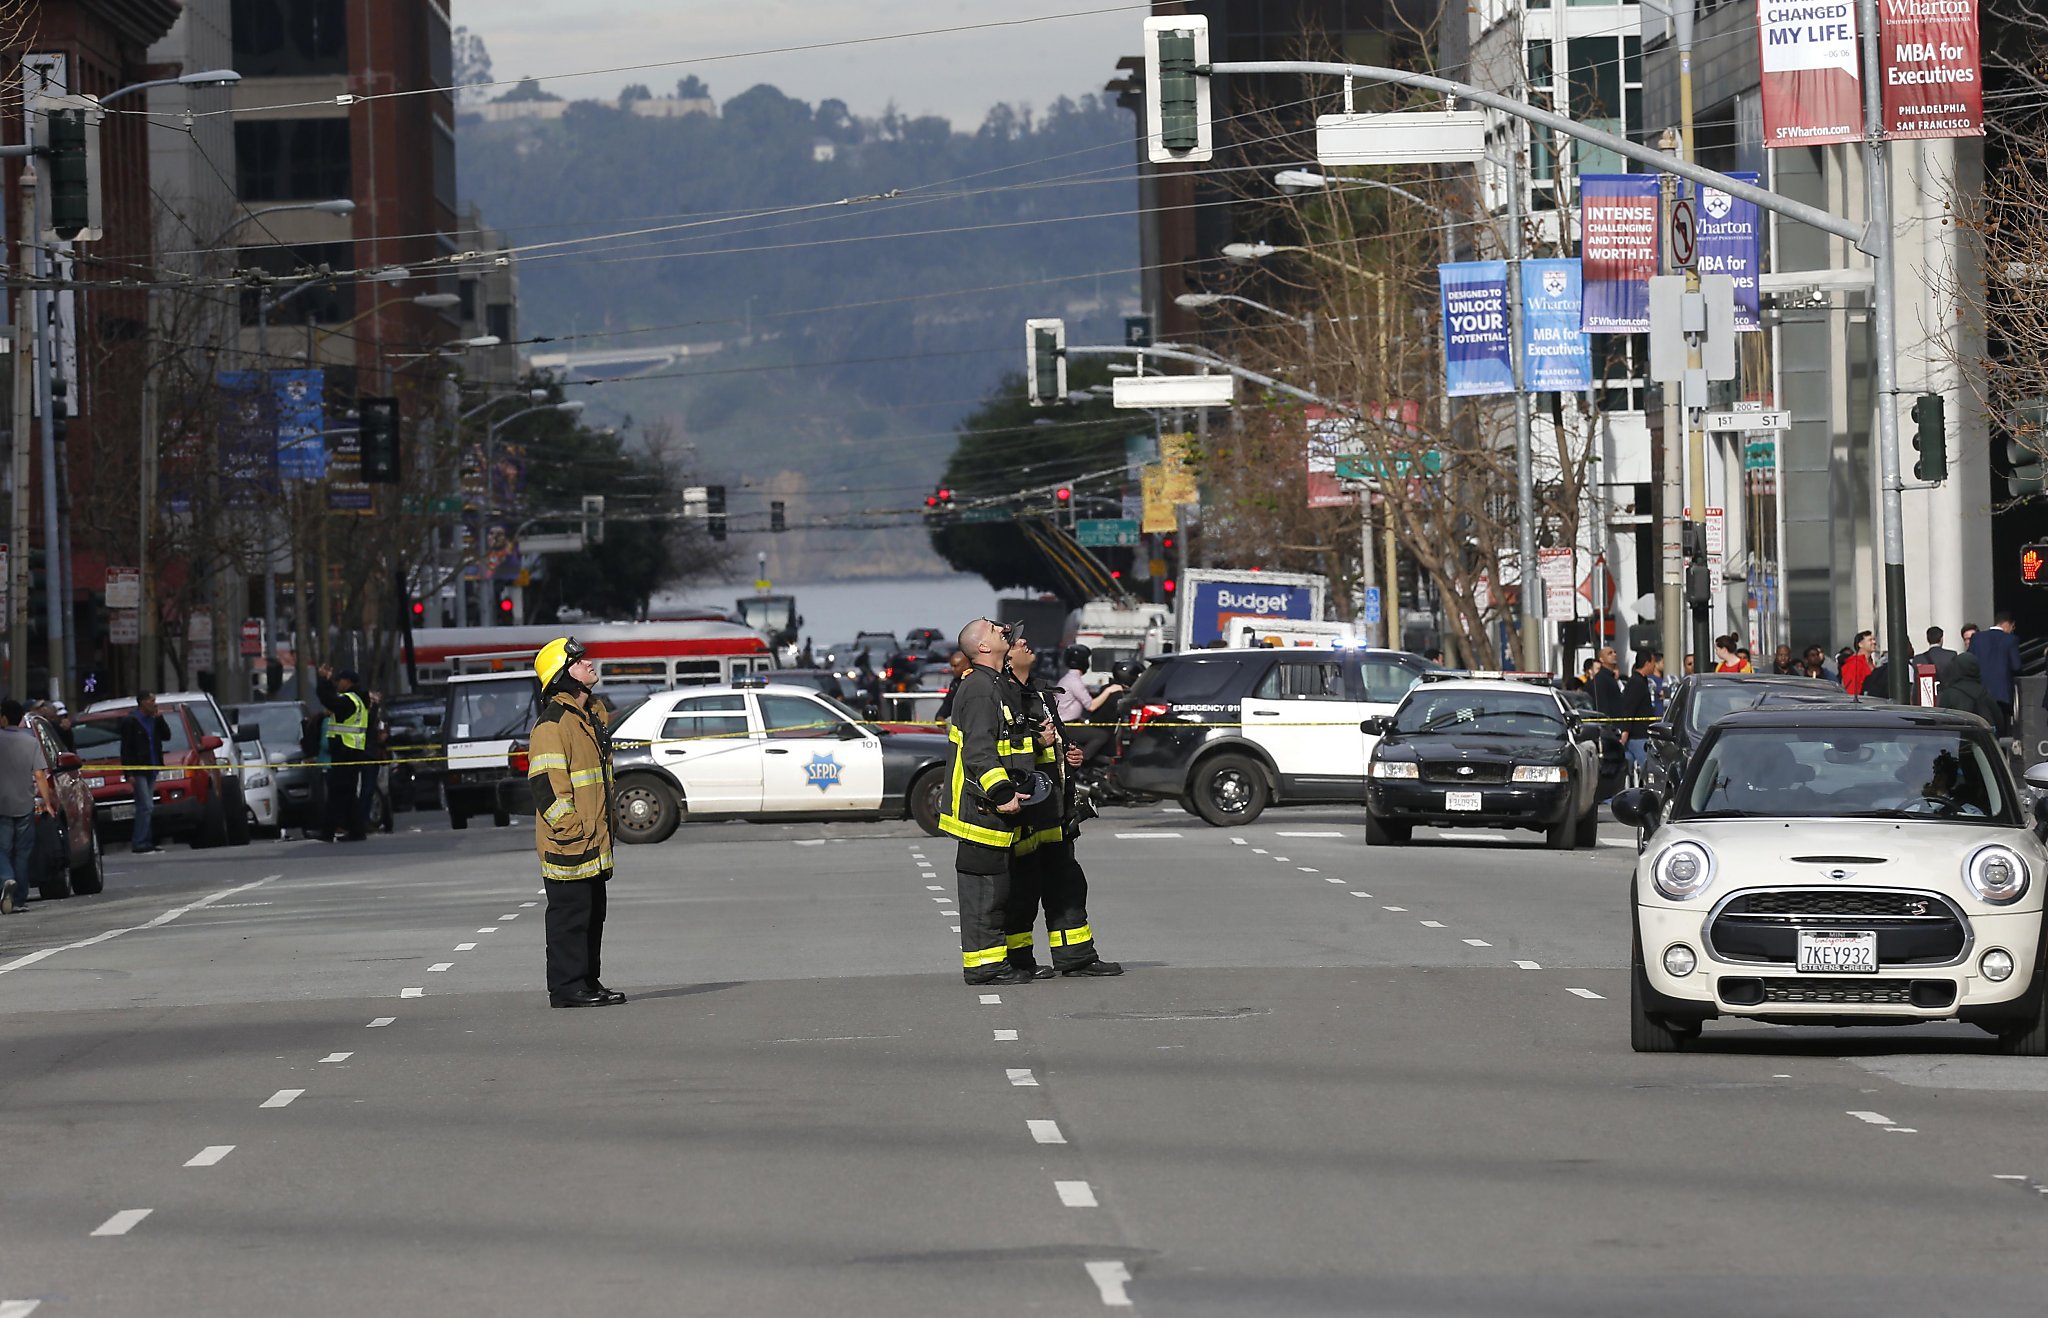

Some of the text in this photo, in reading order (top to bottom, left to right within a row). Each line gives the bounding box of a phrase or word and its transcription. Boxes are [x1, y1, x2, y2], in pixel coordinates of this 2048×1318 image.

[1768, 5, 1846, 22] CHANGED
[1887, 0, 1970, 16] Wharton
[1769, 24, 1853, 45] MY LIFE.
[1896, 42, 1964, 62] MBA for
[1888, 65, 1974, 85] Executives
[1898, 104, 1966, 116] PHILADELPHIA
[1896, 119, 1970, 130] SAN FRANCISCO
[1776, 126, 1850, 138] SFWharton.com
[1588, 207, 1654, 222] INTENSE,
[1588, 224, 1652, 232] CHALLENGING
[1588, 236, 1652, 244] AND TOTALLY
[1588, 248, 1654, 260] WORTH IT.
[1727, 255, 1747, 270] for
[1448, 288, 1502, 300] DESIGNED TO
[1449, 299, 1502, 314] UNLOCK
[1450, 313, 1504, 332] YOUR
[1589, 317, 1648, 326] SFWharton.com
[1452, 332, 1506, 344] POTENTIAL.
[1534, 328, 1580, 340] MBA for
[1528, 343, 1585, 356] Executives
[1736, 404, 1752, 412] 200
[1718, 416, 1779, 427] 1ST ST
[1218, 589, 1288, 614] Budget
[1804, 946, 1870, 964] 7KEY932
